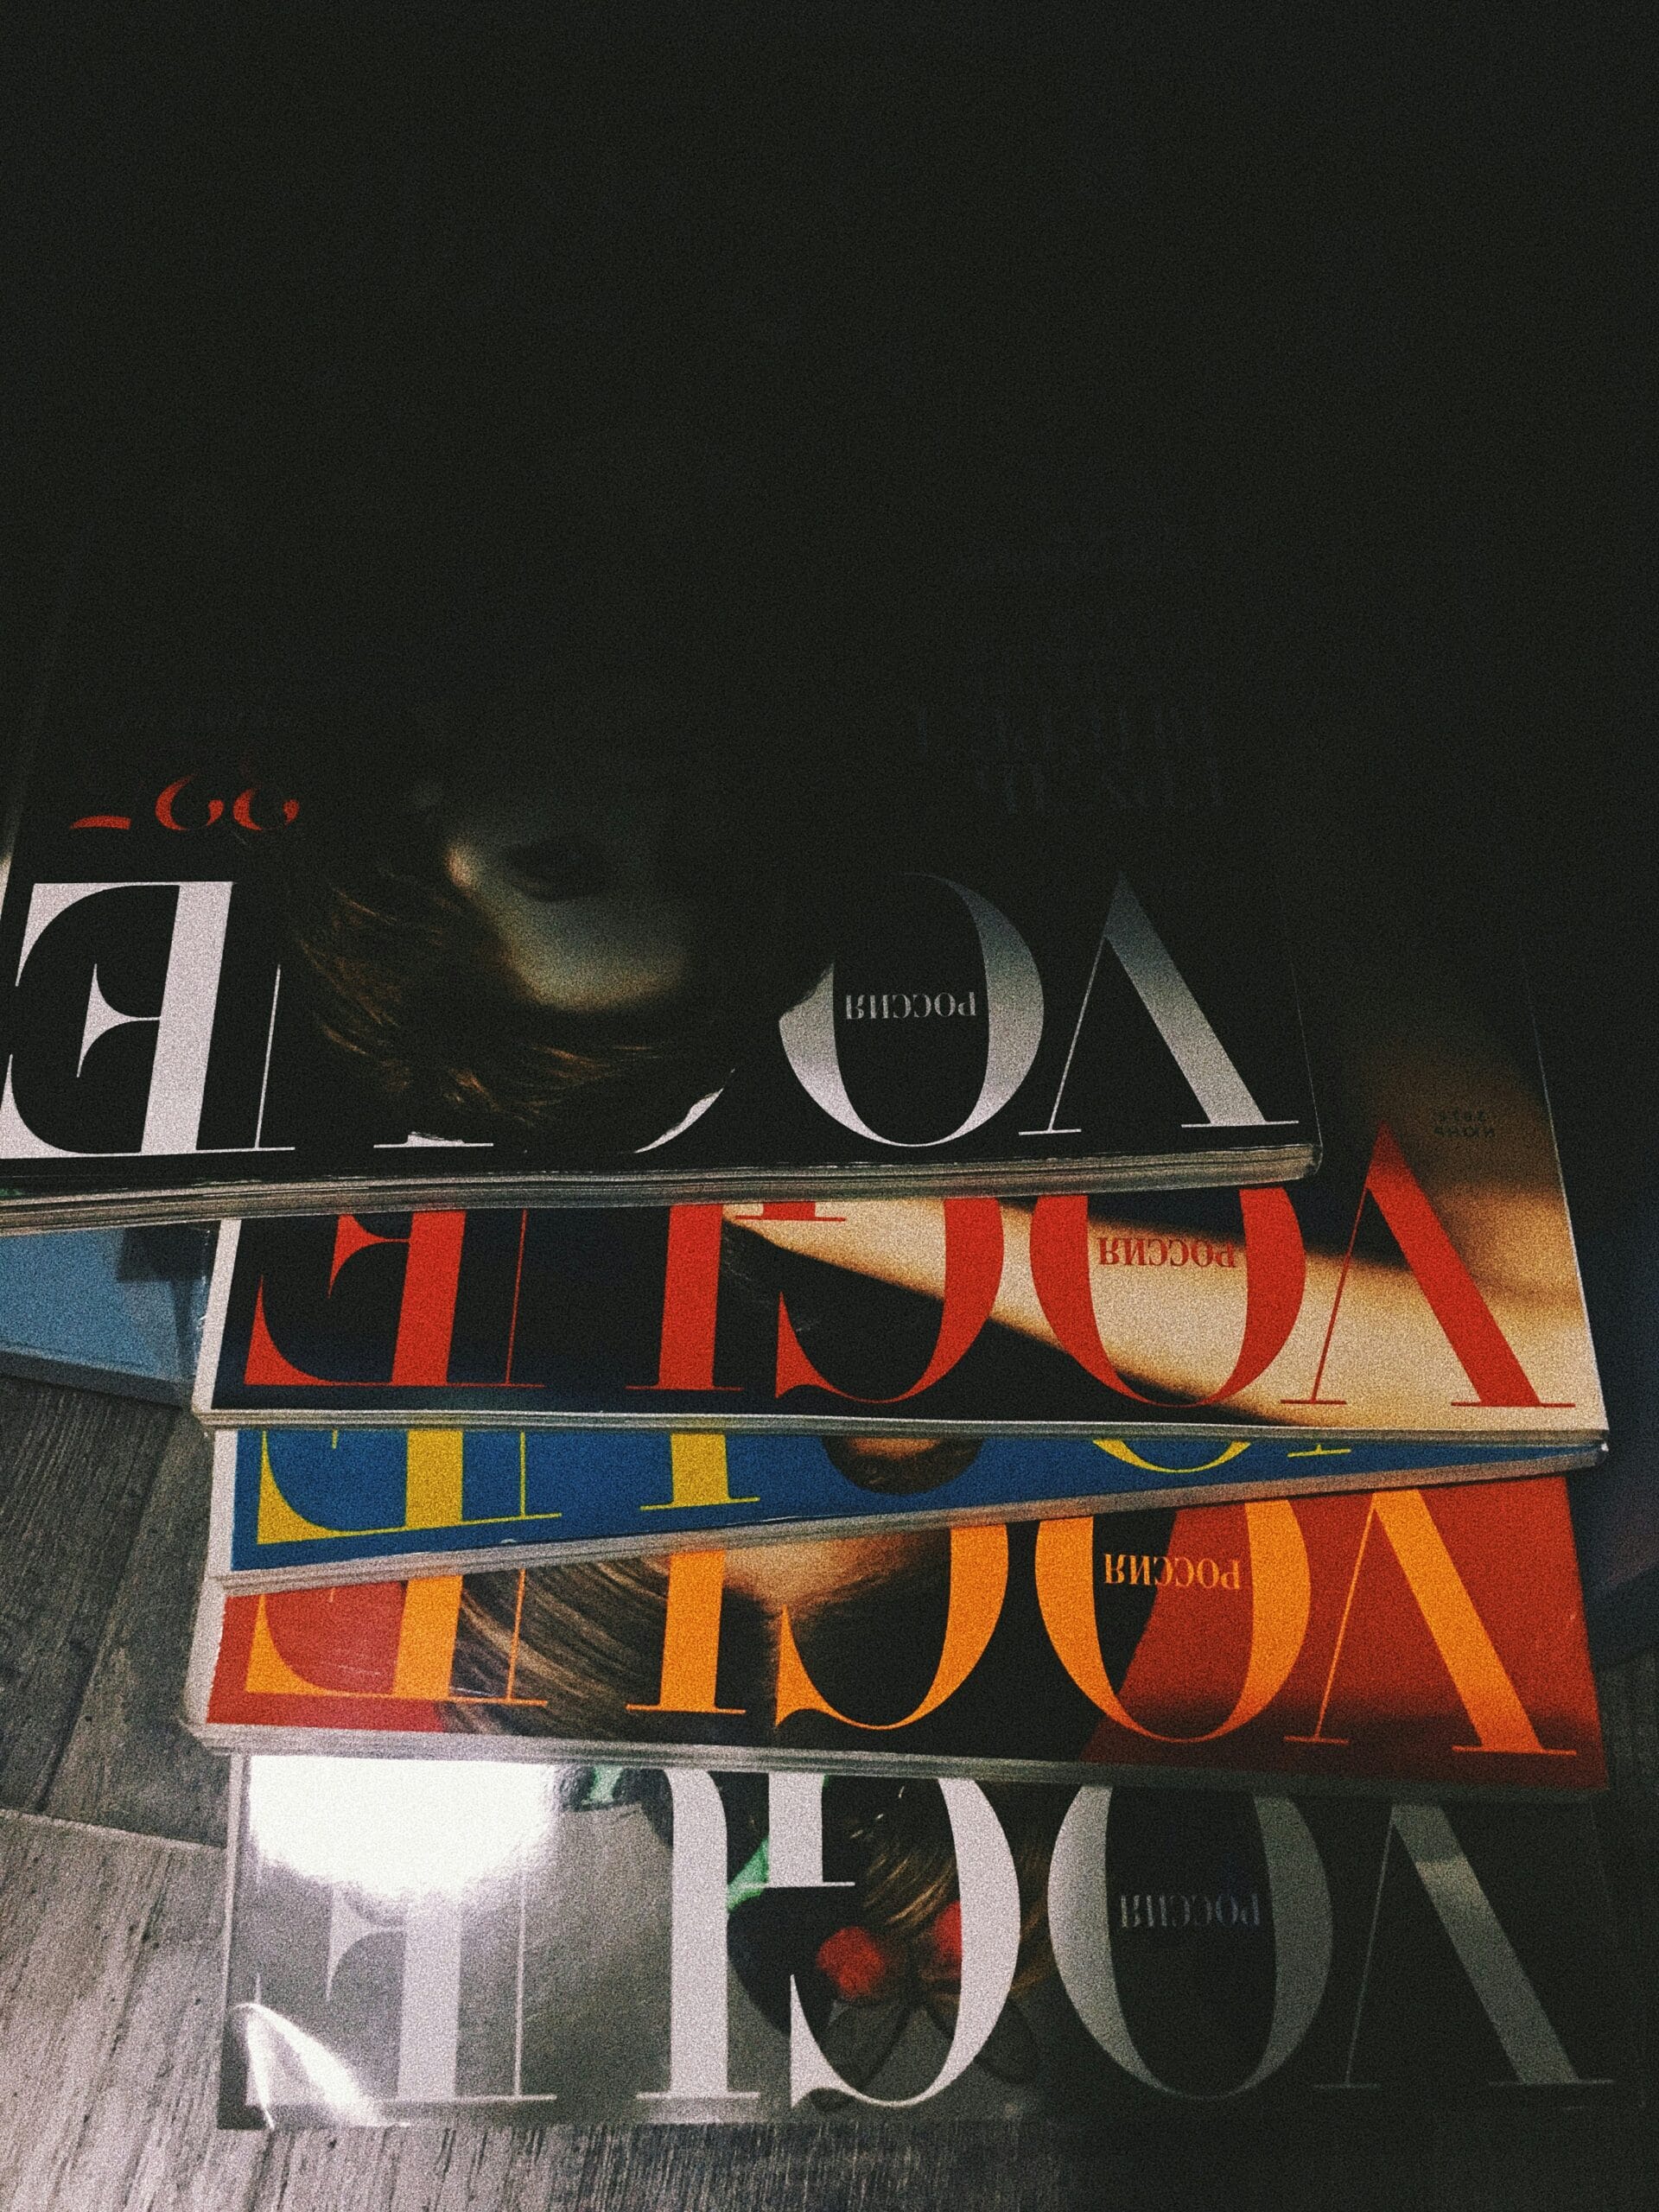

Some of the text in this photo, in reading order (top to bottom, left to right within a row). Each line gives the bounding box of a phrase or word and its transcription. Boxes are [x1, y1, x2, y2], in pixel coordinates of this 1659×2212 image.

[0, 873, 1300, 1160] VOE
[846, 992, 977, 1021] РОССИЯ
[245, 1124, 1576, 1408] VOGUE
[1098, 1236, 1237, 1268] РОССИЯ
[1104, 1554, 1242, 1590] РОССИЯ
[1120, 1893, 1261, 1929] РОССИЯ
[245, 1770, 1614, 2110] VOGUE
